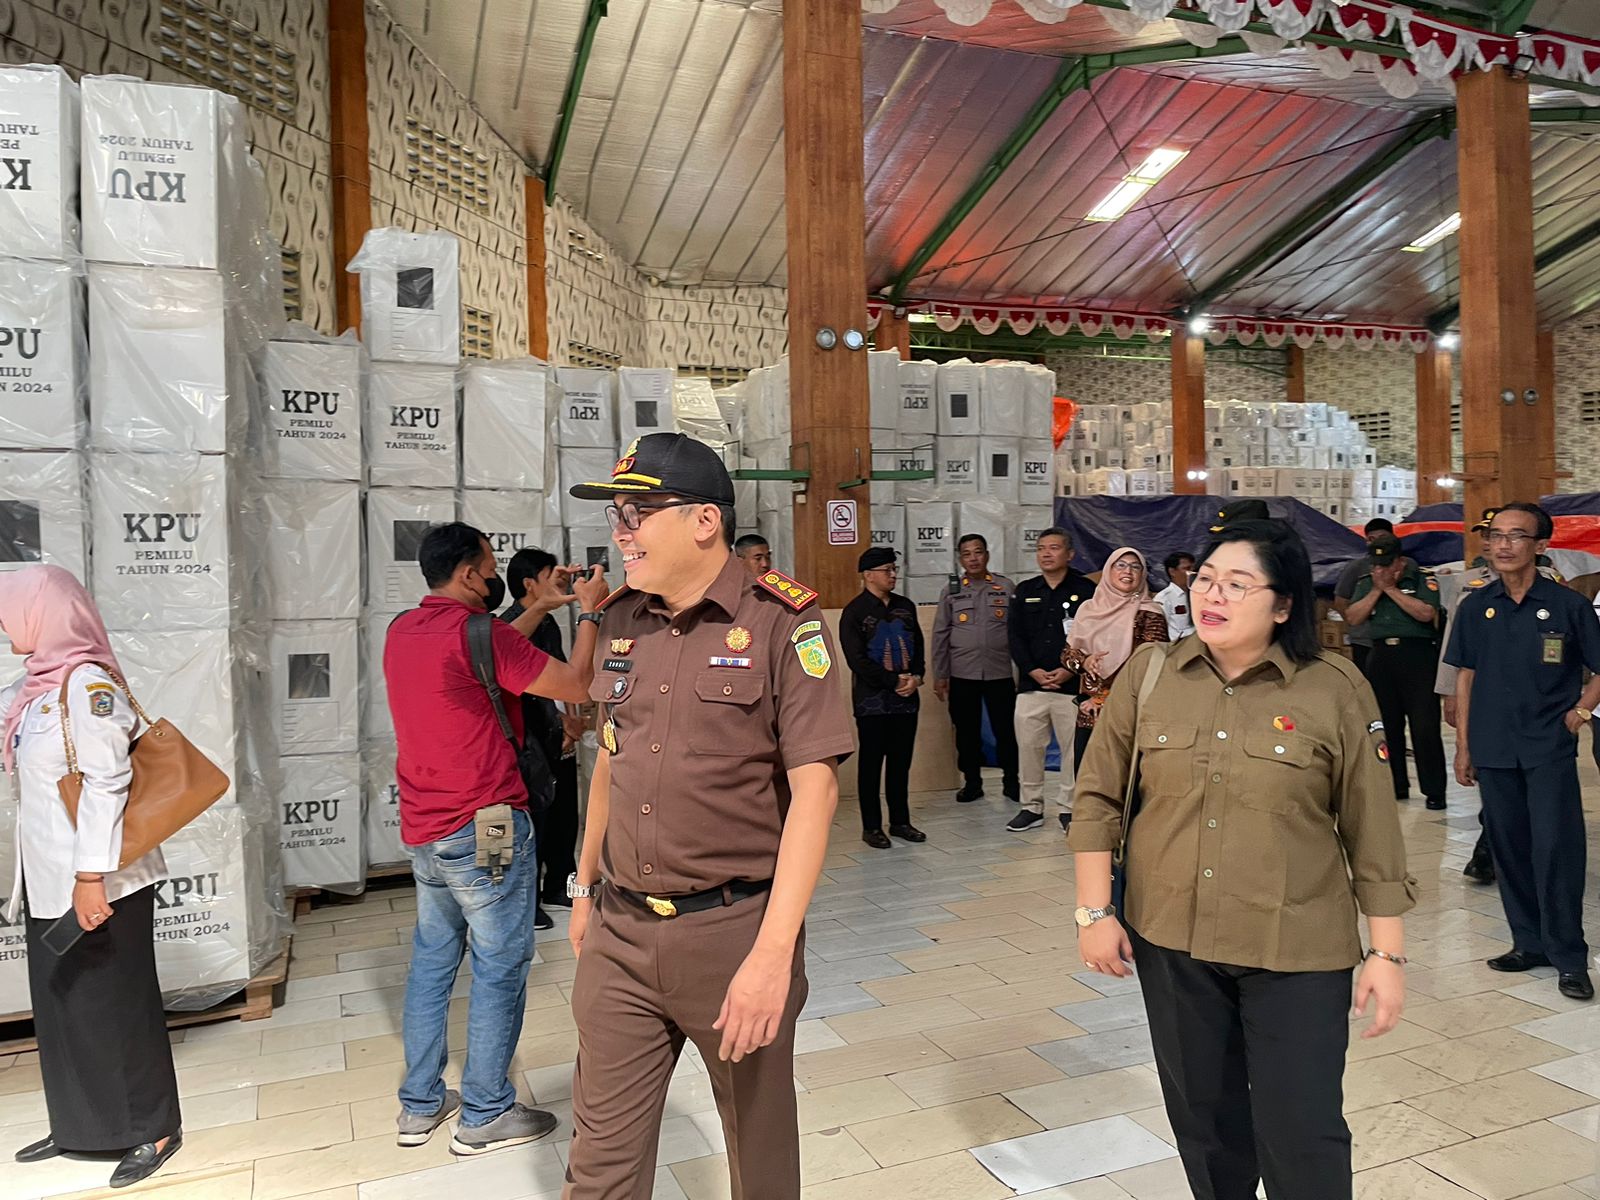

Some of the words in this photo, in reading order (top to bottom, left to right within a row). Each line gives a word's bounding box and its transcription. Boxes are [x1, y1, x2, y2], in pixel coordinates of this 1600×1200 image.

[98, 134, 137, 146] 2024
[142, 137, 194, 151] TAHUN
[118, 150, 176, 165] PEMILU
[108, 168, 187, 203] KPU
[0, 326, 41, 360] PU
[13, 382, 53, 393] 2024
[281, 389, 340, 416] KPU
[904, 396, 929, 410] KPU
[390, 405, 441, 429] KPU
[569, 405, 600, 420] KPU
[289, 418, 334, 429] PEMILU
[276, 429, 316, 439] TAHUN
[319, 429, 347, 440] 2024
[396, 431, 436, 441] PEMILU
[422, 442, 448, 451] 2024
[899, 459, 925, 471] KPU
[946, 460, 971, 473] KPU
[1024, 461, 1047, 474] KPU
[122, 512, 202, 544] KPU
[917, 527, 944, 540] KPU
[870, 530, 896, 543] KPU
[1023, 529, 1041, 541] KP
[135, 549, 194, 561] PEMILU
[116, 564, 170, 576] TAHUN
[174, 563, 212, 575] 2024
[282, 799, 340, 825] KPU
[290, 827, 334, 838] PEMILU
[319, 837, 346, 846] 2024
[154, 910, 212, 928] PEMILU
[193, 922, 231, 936] 2024
